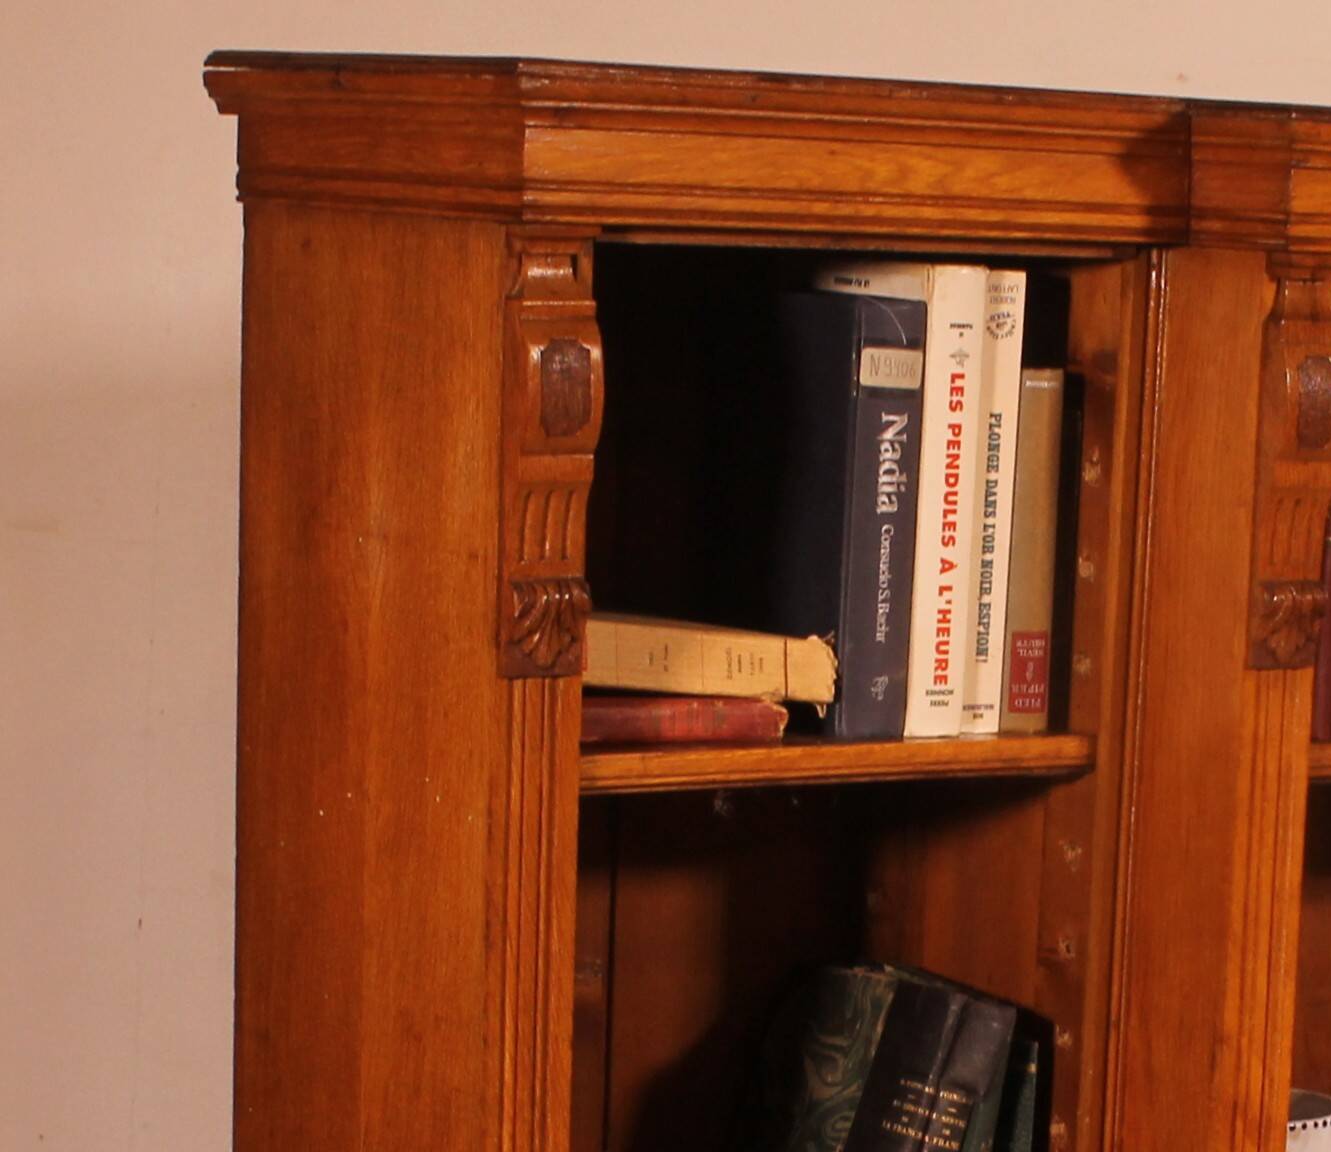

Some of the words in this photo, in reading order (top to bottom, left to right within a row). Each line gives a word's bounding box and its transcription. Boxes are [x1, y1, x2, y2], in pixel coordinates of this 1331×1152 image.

[949, 373, 966, 413] LES
[876, 411, 909, 515] Nadia
[986, 411, 1003, 474] PLONGE
[941, 423, 963, 548] PENDULES
[983, 479, 999, 519] DANS
[981, 523, 997, 555] L'OR
[938, 557, 958, 575] À
[933, 585, 953, 687] L'HEURE
